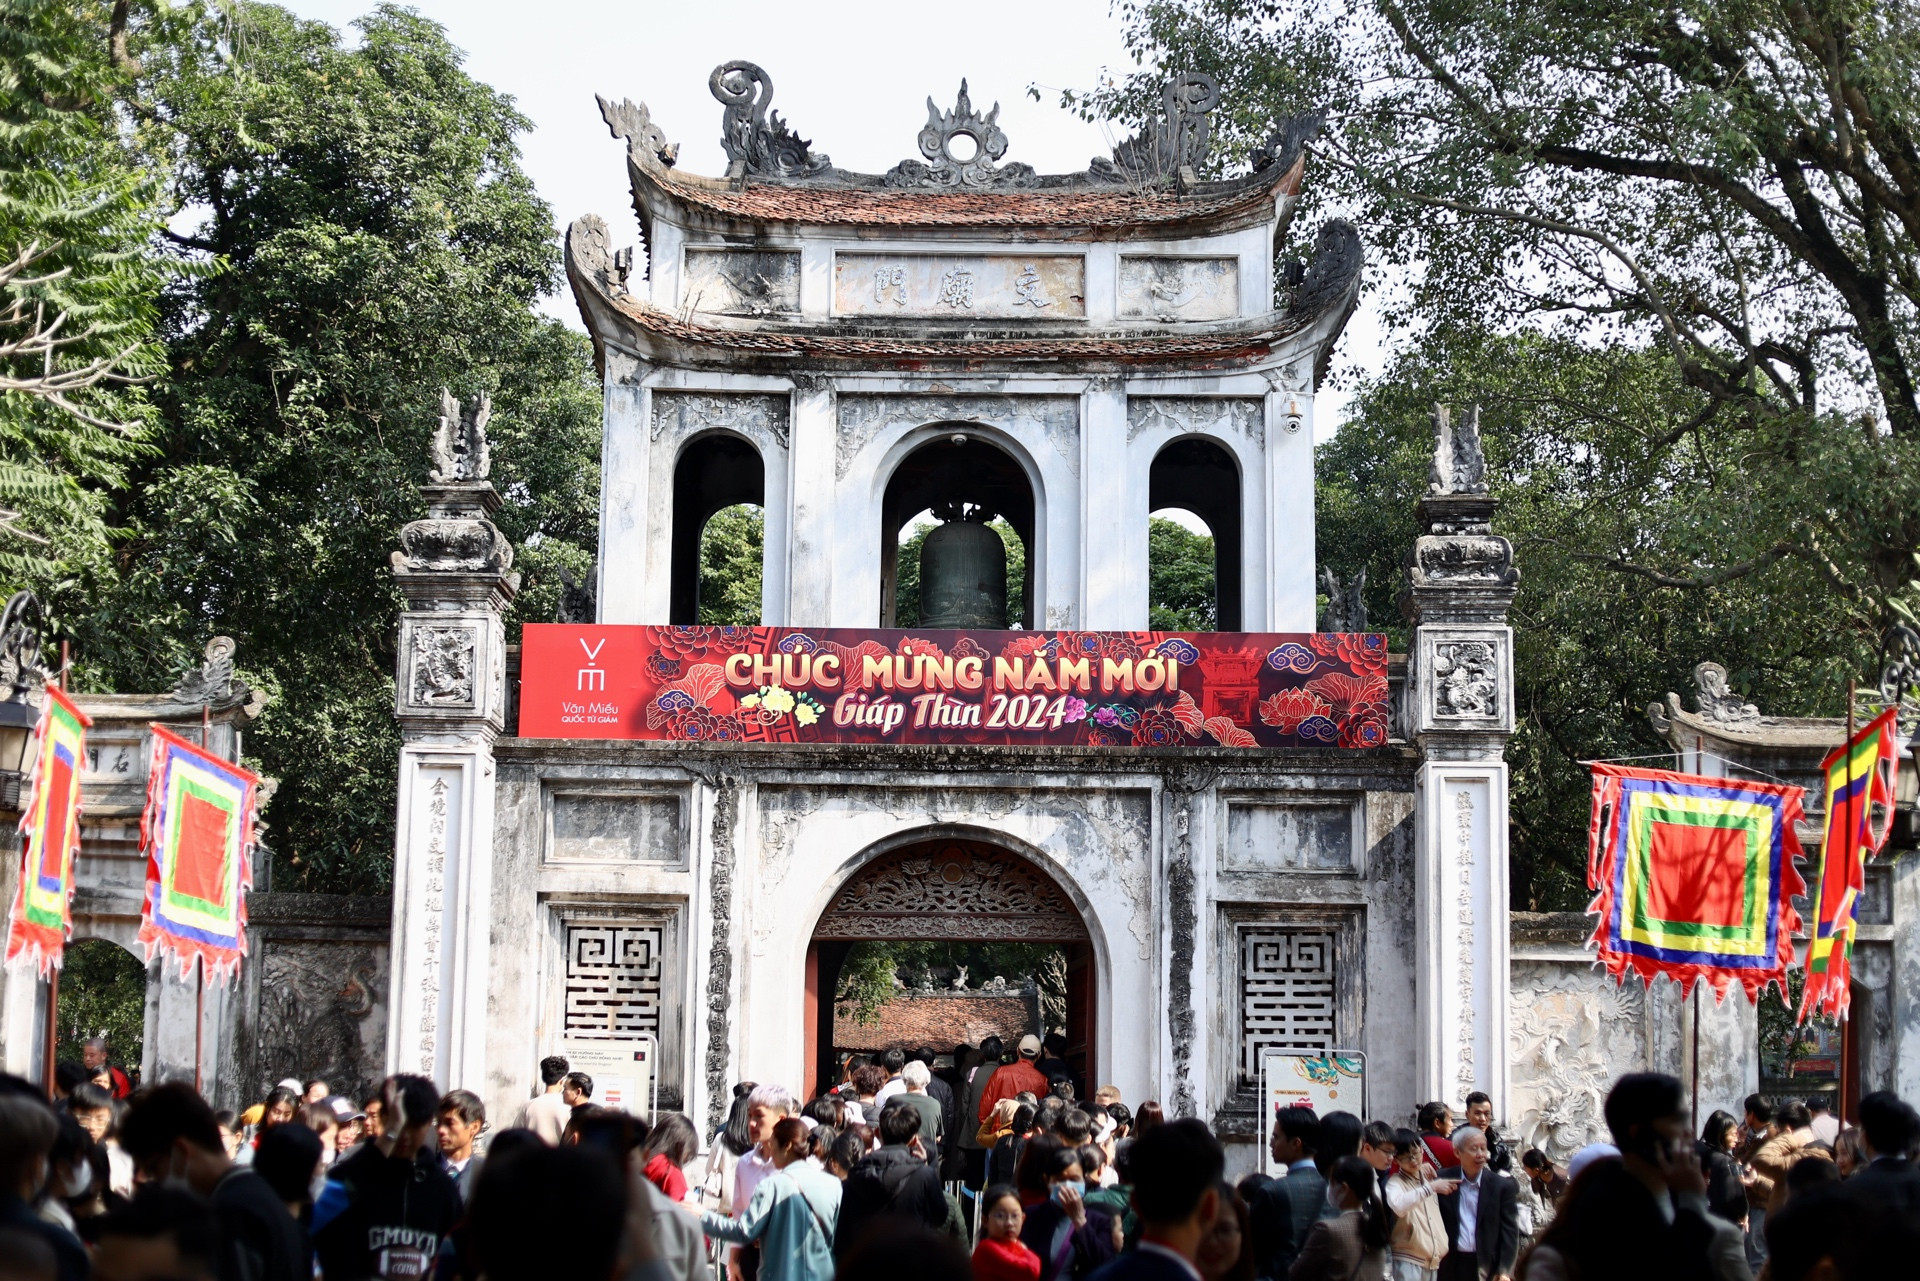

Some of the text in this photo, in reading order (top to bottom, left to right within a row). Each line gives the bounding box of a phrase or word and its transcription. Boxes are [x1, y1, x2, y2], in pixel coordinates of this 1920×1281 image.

[725, 643, 1180, 692] CHÚC MỪNG NĂM MỚI
[561, 713, 585, 723] QUỐC
[597, 714, 619, 723] GIÁM
[562, 701, 618, 714] Văn Miếu
[832, 690, 1068, 736] Giáp Thìn 2024
